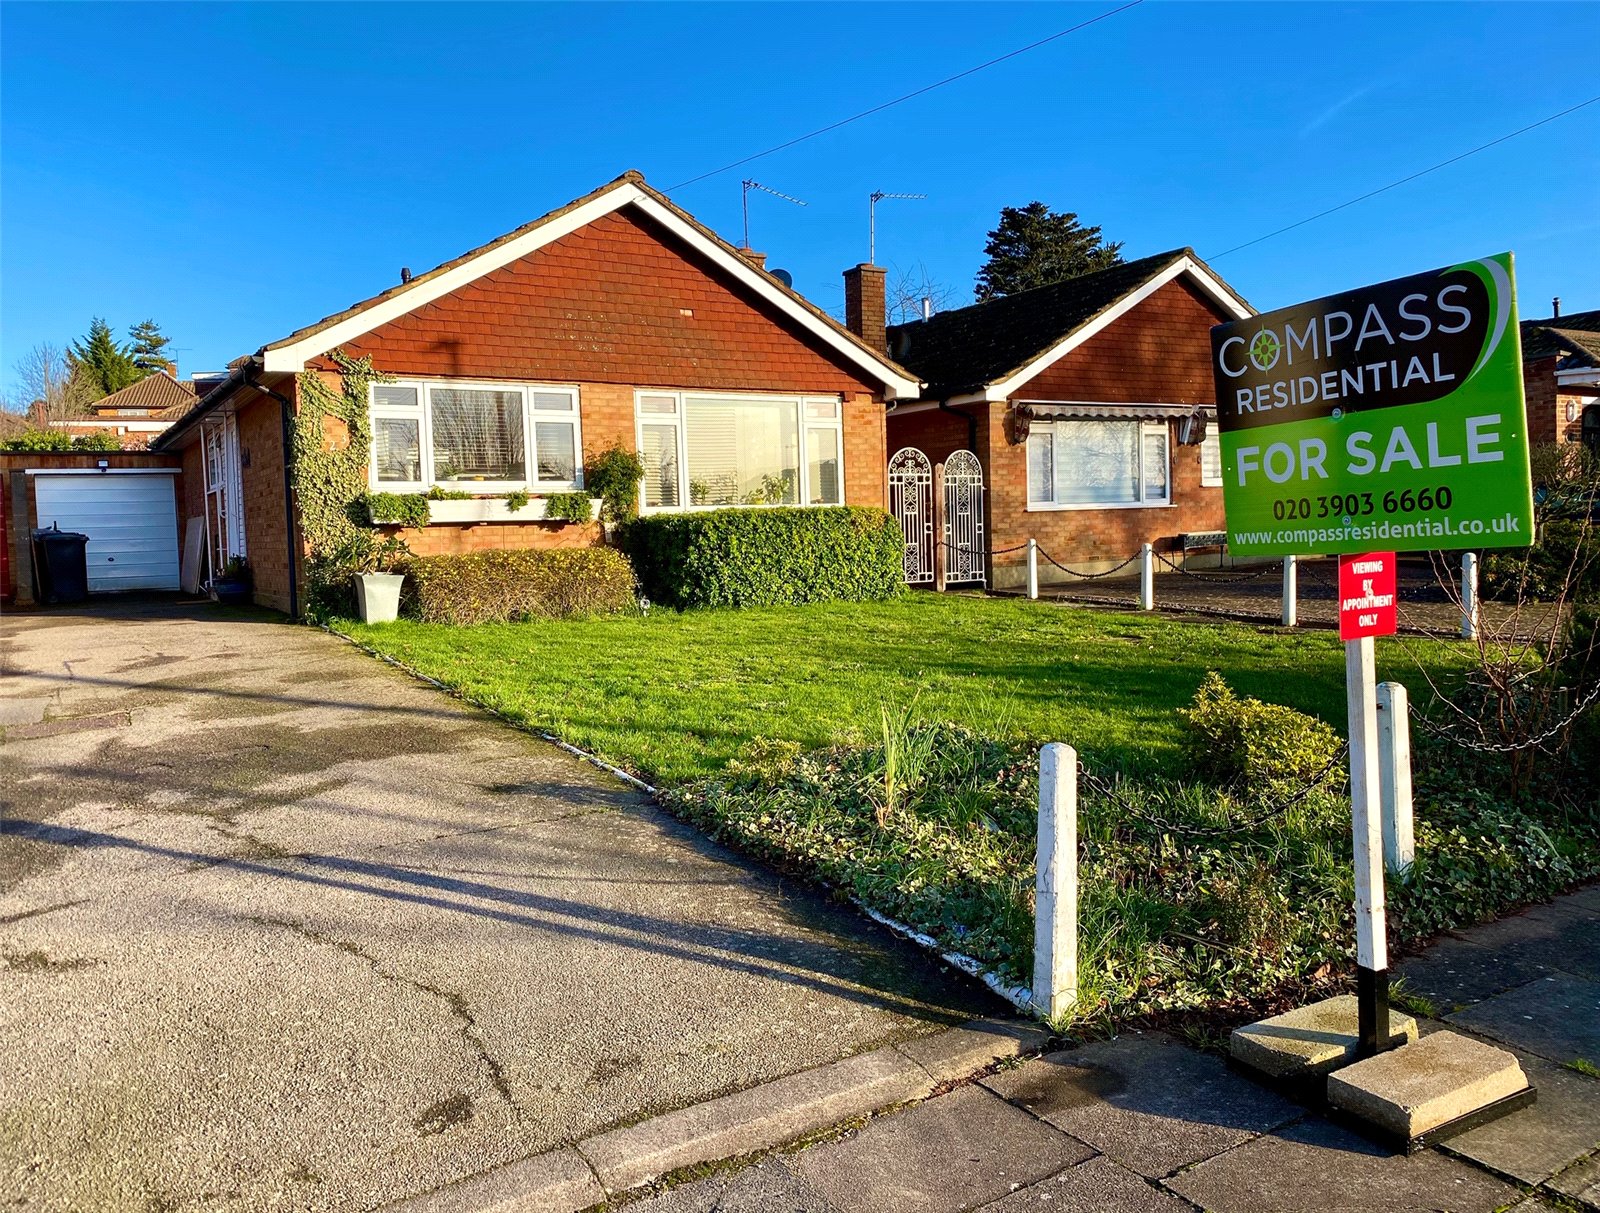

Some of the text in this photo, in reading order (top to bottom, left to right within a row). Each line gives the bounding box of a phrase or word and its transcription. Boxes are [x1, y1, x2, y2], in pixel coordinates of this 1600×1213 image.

[1219, 284, 1472, 378] COMPASS
[1236, 353, 1456, 415] RESIDENTIAL
[1236, 413, 1504, 487] FOR SALE
[1273, 486, 1453, 521] 020 3903 6660
[1235, 513, 1520, 547] www.compassresidential.co.uk
[1351, 560, 1383, 575] VIEWING
[1362, 579, 1373, 591] BY
[1342, 594, 1393, 611] APPOINTMENT
[1358, 613, 1378, 627] ONLY
